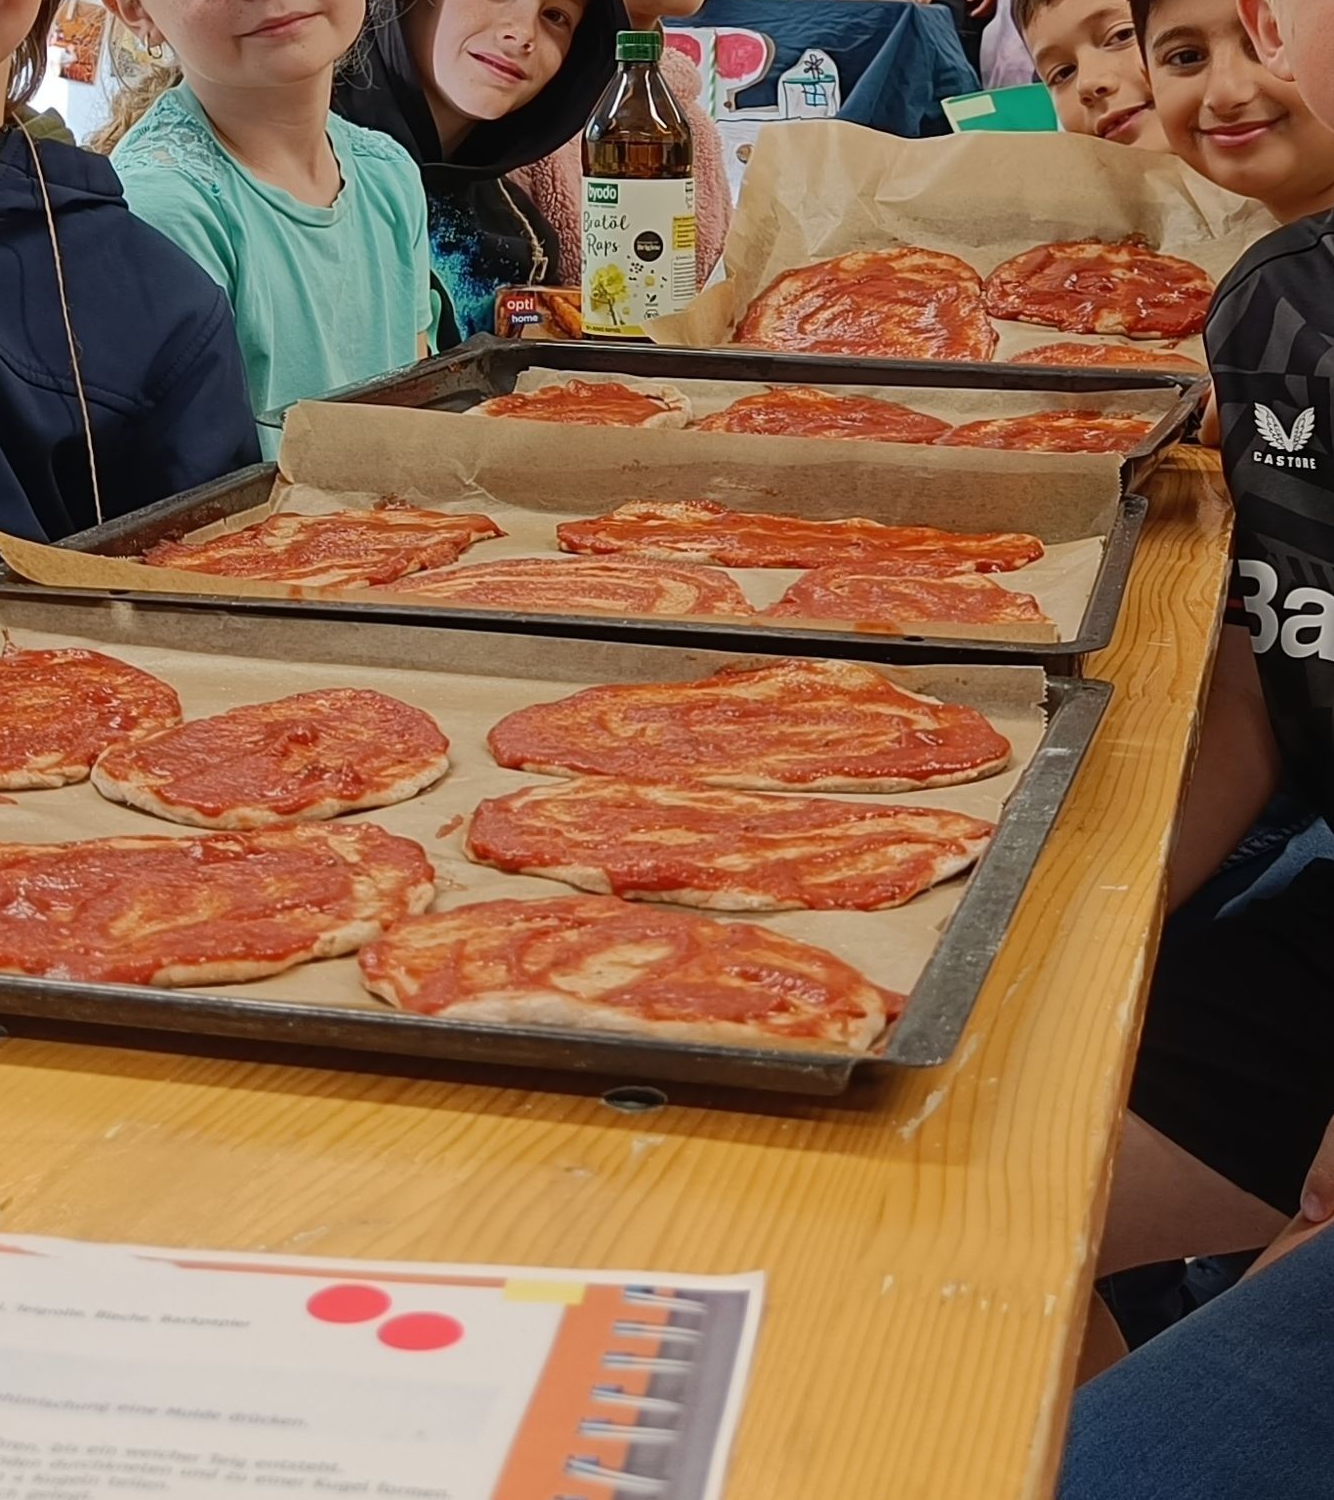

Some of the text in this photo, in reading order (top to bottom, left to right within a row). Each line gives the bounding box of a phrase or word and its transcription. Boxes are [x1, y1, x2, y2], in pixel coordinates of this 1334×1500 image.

[586, 233, 620, 257] Raps
[507, 298, 534, 311] opti
[511, 314, 539, 323] home
[1253, 451, 1317, 469] CASTORE
